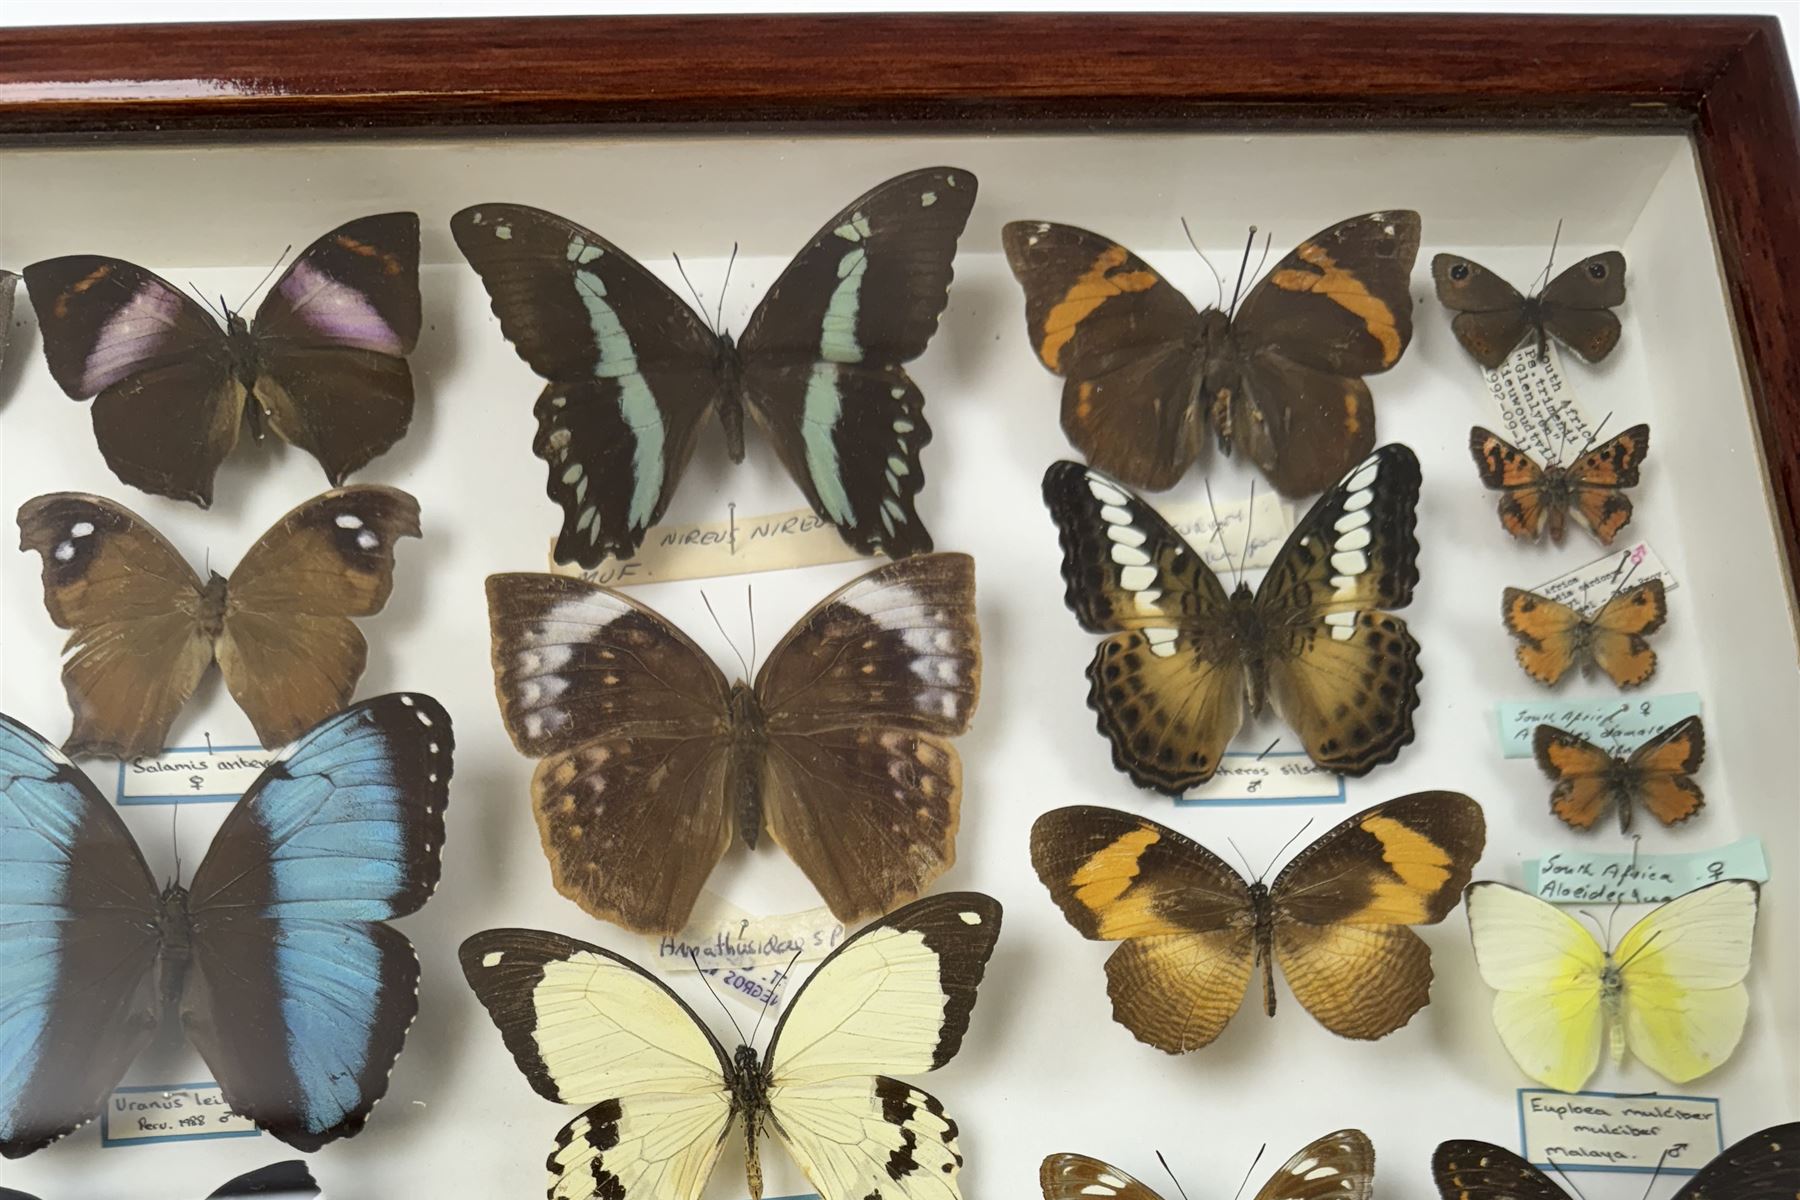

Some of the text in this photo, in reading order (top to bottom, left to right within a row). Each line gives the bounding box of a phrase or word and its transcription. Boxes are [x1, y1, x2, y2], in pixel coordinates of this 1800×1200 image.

[1486, 371, 1532, 453] 992-09-11
[750, 516, 838, 540] NIREU
[132, 757, 209, 775] Salamis
[114, 1096, 184, 1113] Uranus
